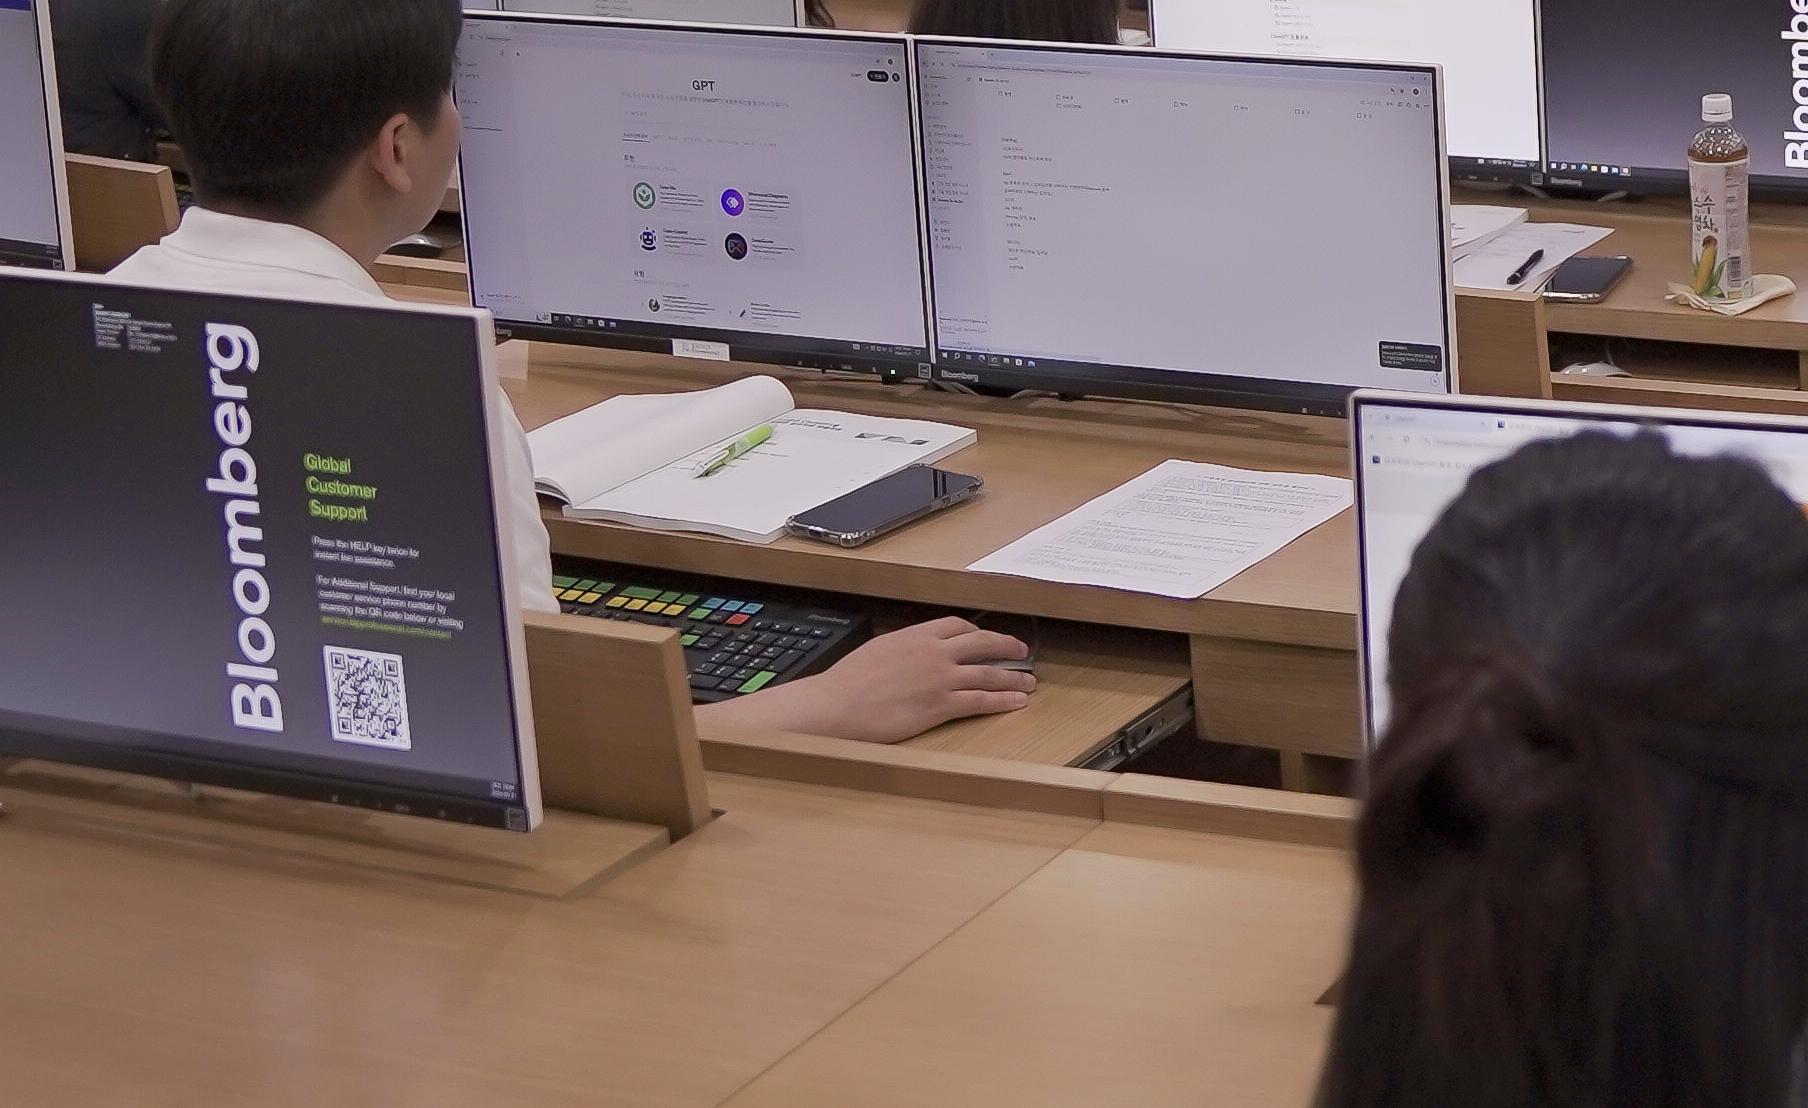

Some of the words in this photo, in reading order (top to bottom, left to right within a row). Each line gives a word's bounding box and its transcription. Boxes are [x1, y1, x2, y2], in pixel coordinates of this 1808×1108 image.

[692, 79, 715, 92] GPT
[304, 453, 351, 474] Global
[306, 476, 378, 500] Customer
[308, 498, 369, 523] Support
[205, 322, 285, 733] Bloomberg
[350, 540, 372, 552] HELP
